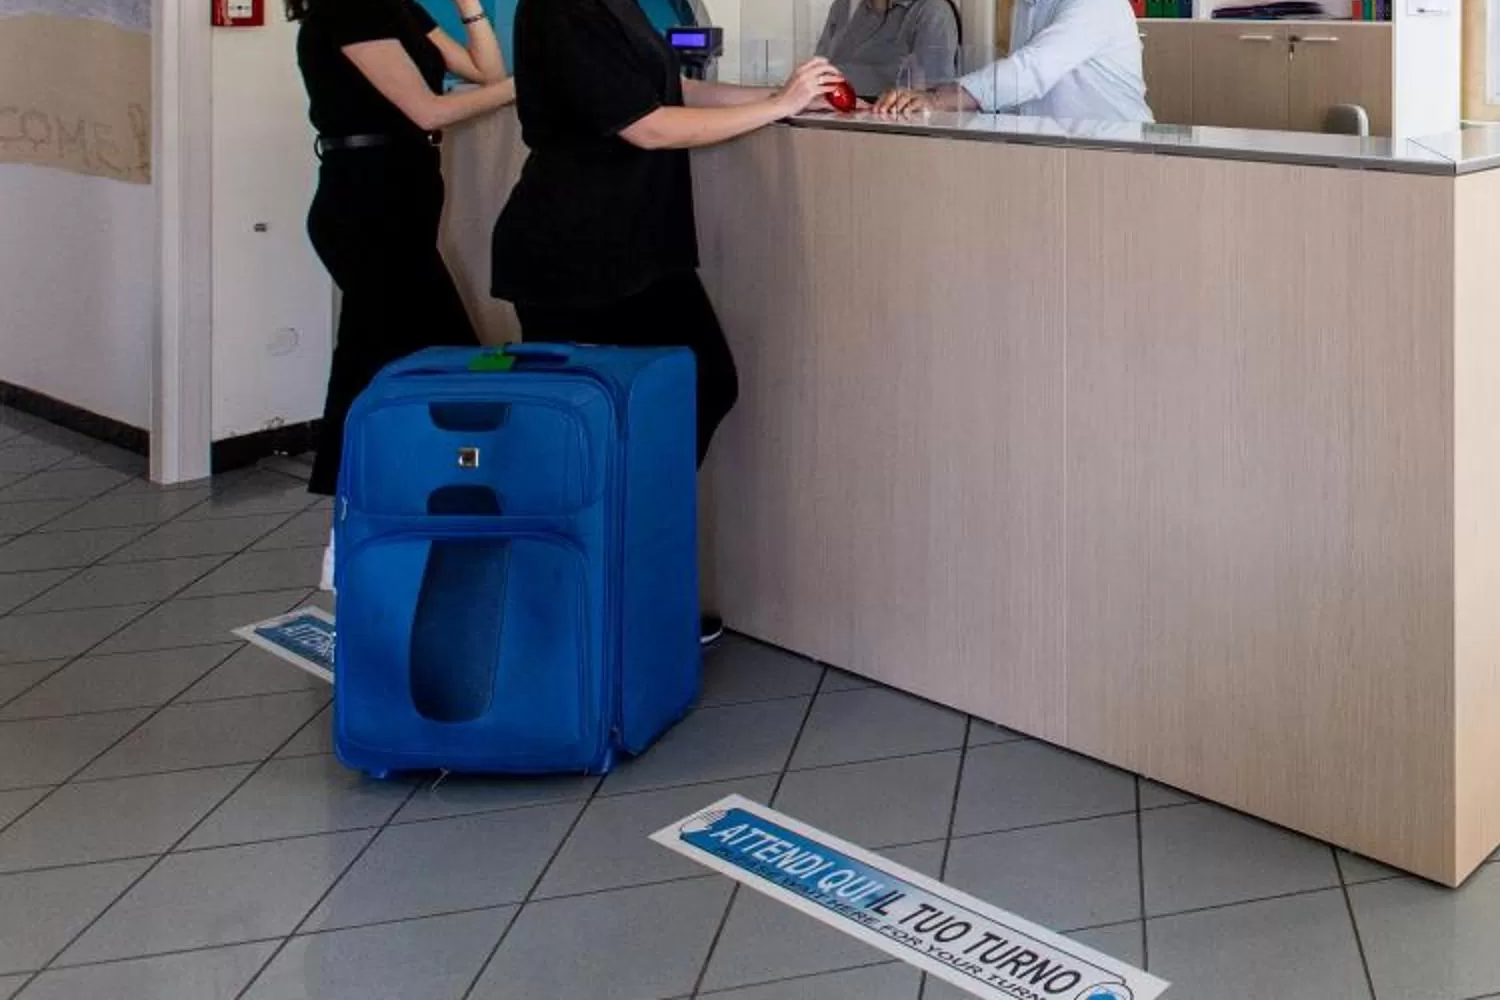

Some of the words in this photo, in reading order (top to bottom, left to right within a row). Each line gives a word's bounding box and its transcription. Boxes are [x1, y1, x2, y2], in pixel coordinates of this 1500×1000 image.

[708, 823, 836, 880] ATTENDI
[816, 868, 885, 903] QUI
[864, 889, 905, 916] IL
[899, 902, 973, 943] TUO
[962, 930, 1083, 995] TURNO
[880, 924, 923, 947] FOR
[925, 943, 984, 975] YOUR
